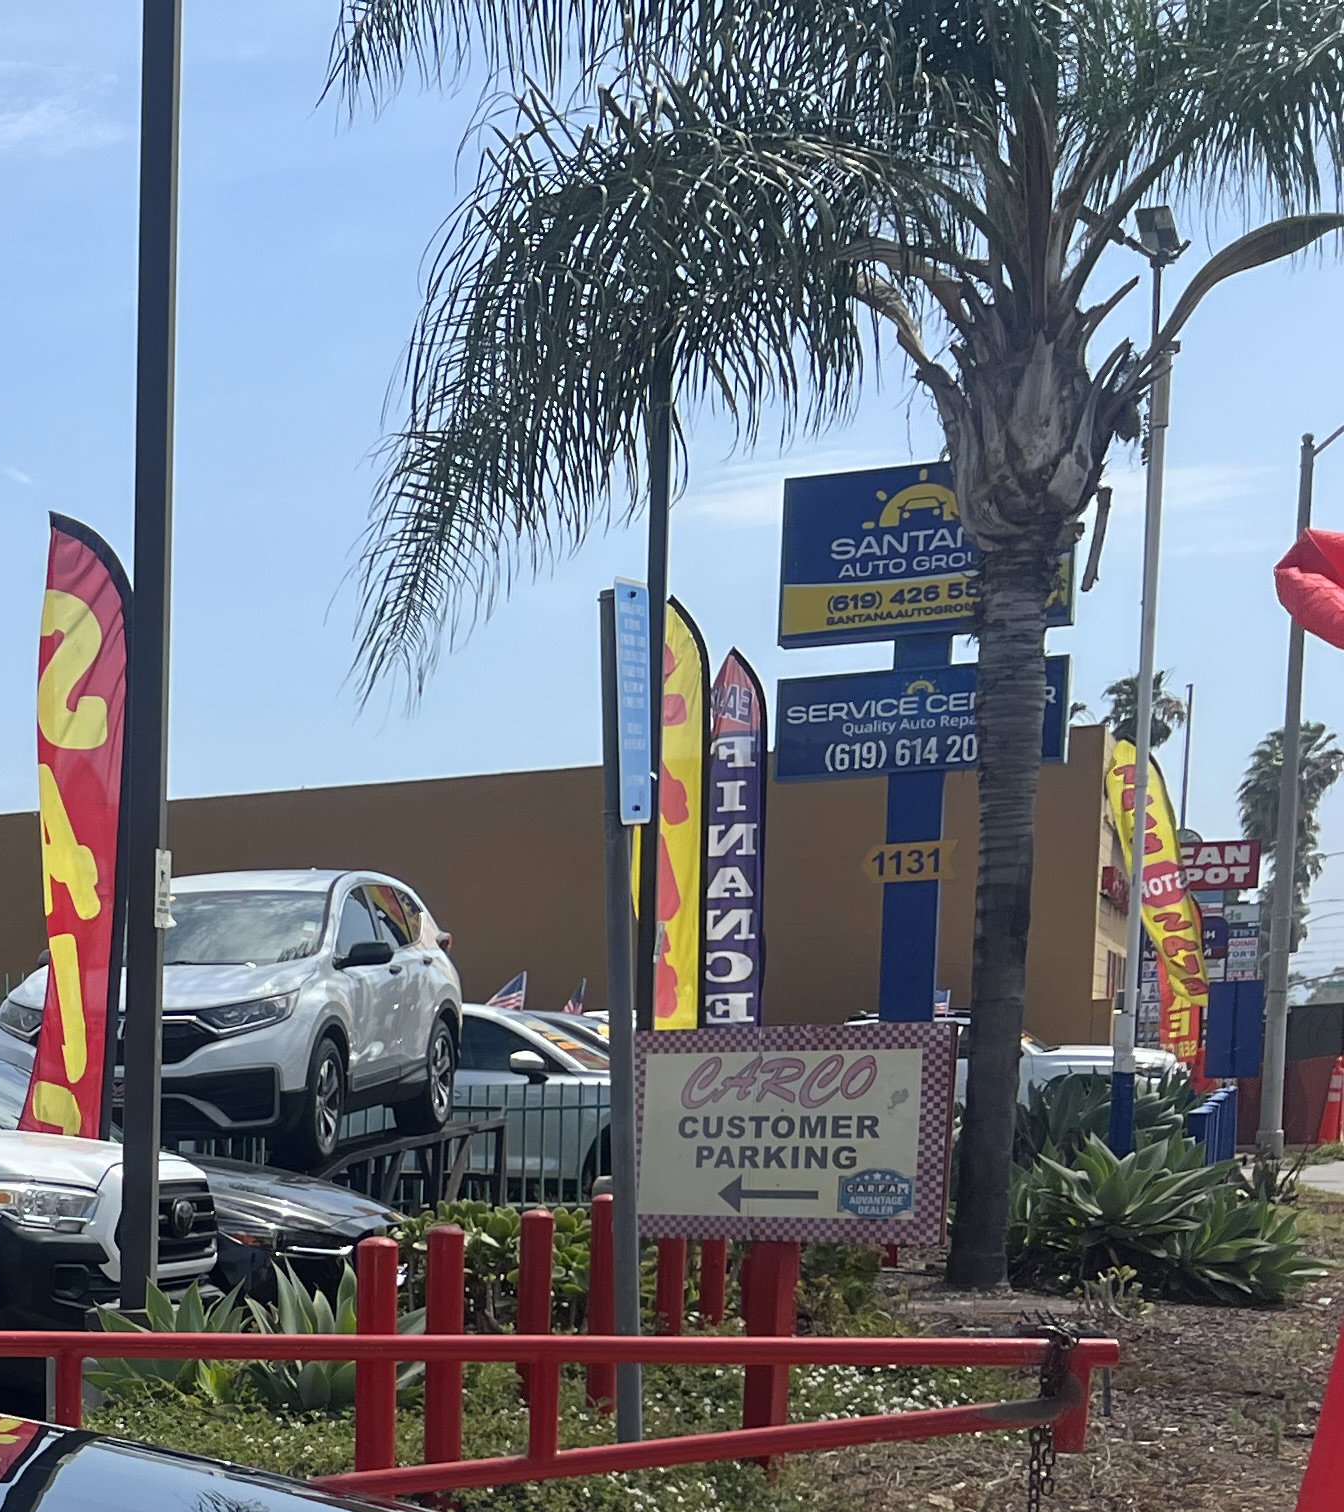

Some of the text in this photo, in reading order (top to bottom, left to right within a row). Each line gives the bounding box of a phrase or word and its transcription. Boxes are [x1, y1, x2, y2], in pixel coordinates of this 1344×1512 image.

[830, 526, 963, 561] SANTA
[838, 551, 973, 579] AUTO GRO
[827, 580, 981, 613] (619) 426 55
[786, 696, 919, 725] SERVICE
[842, 714, 977, 736] Quality Auto Repa
[824, 735, 977, 772] (619) 614 20
[872, 848, 940, 876] 1131
[681, 1054, 877, 1109] CARCO
[678, 1114, 880, 1140] CUSTOMER
[695, 1145, 858, 1170] PARKING
[846, 1183, 909, 1194] CARFAX
[849, 1195, 904, 1206] ADVANTAGE
[857, 1205, 894, 1215] DEALER
